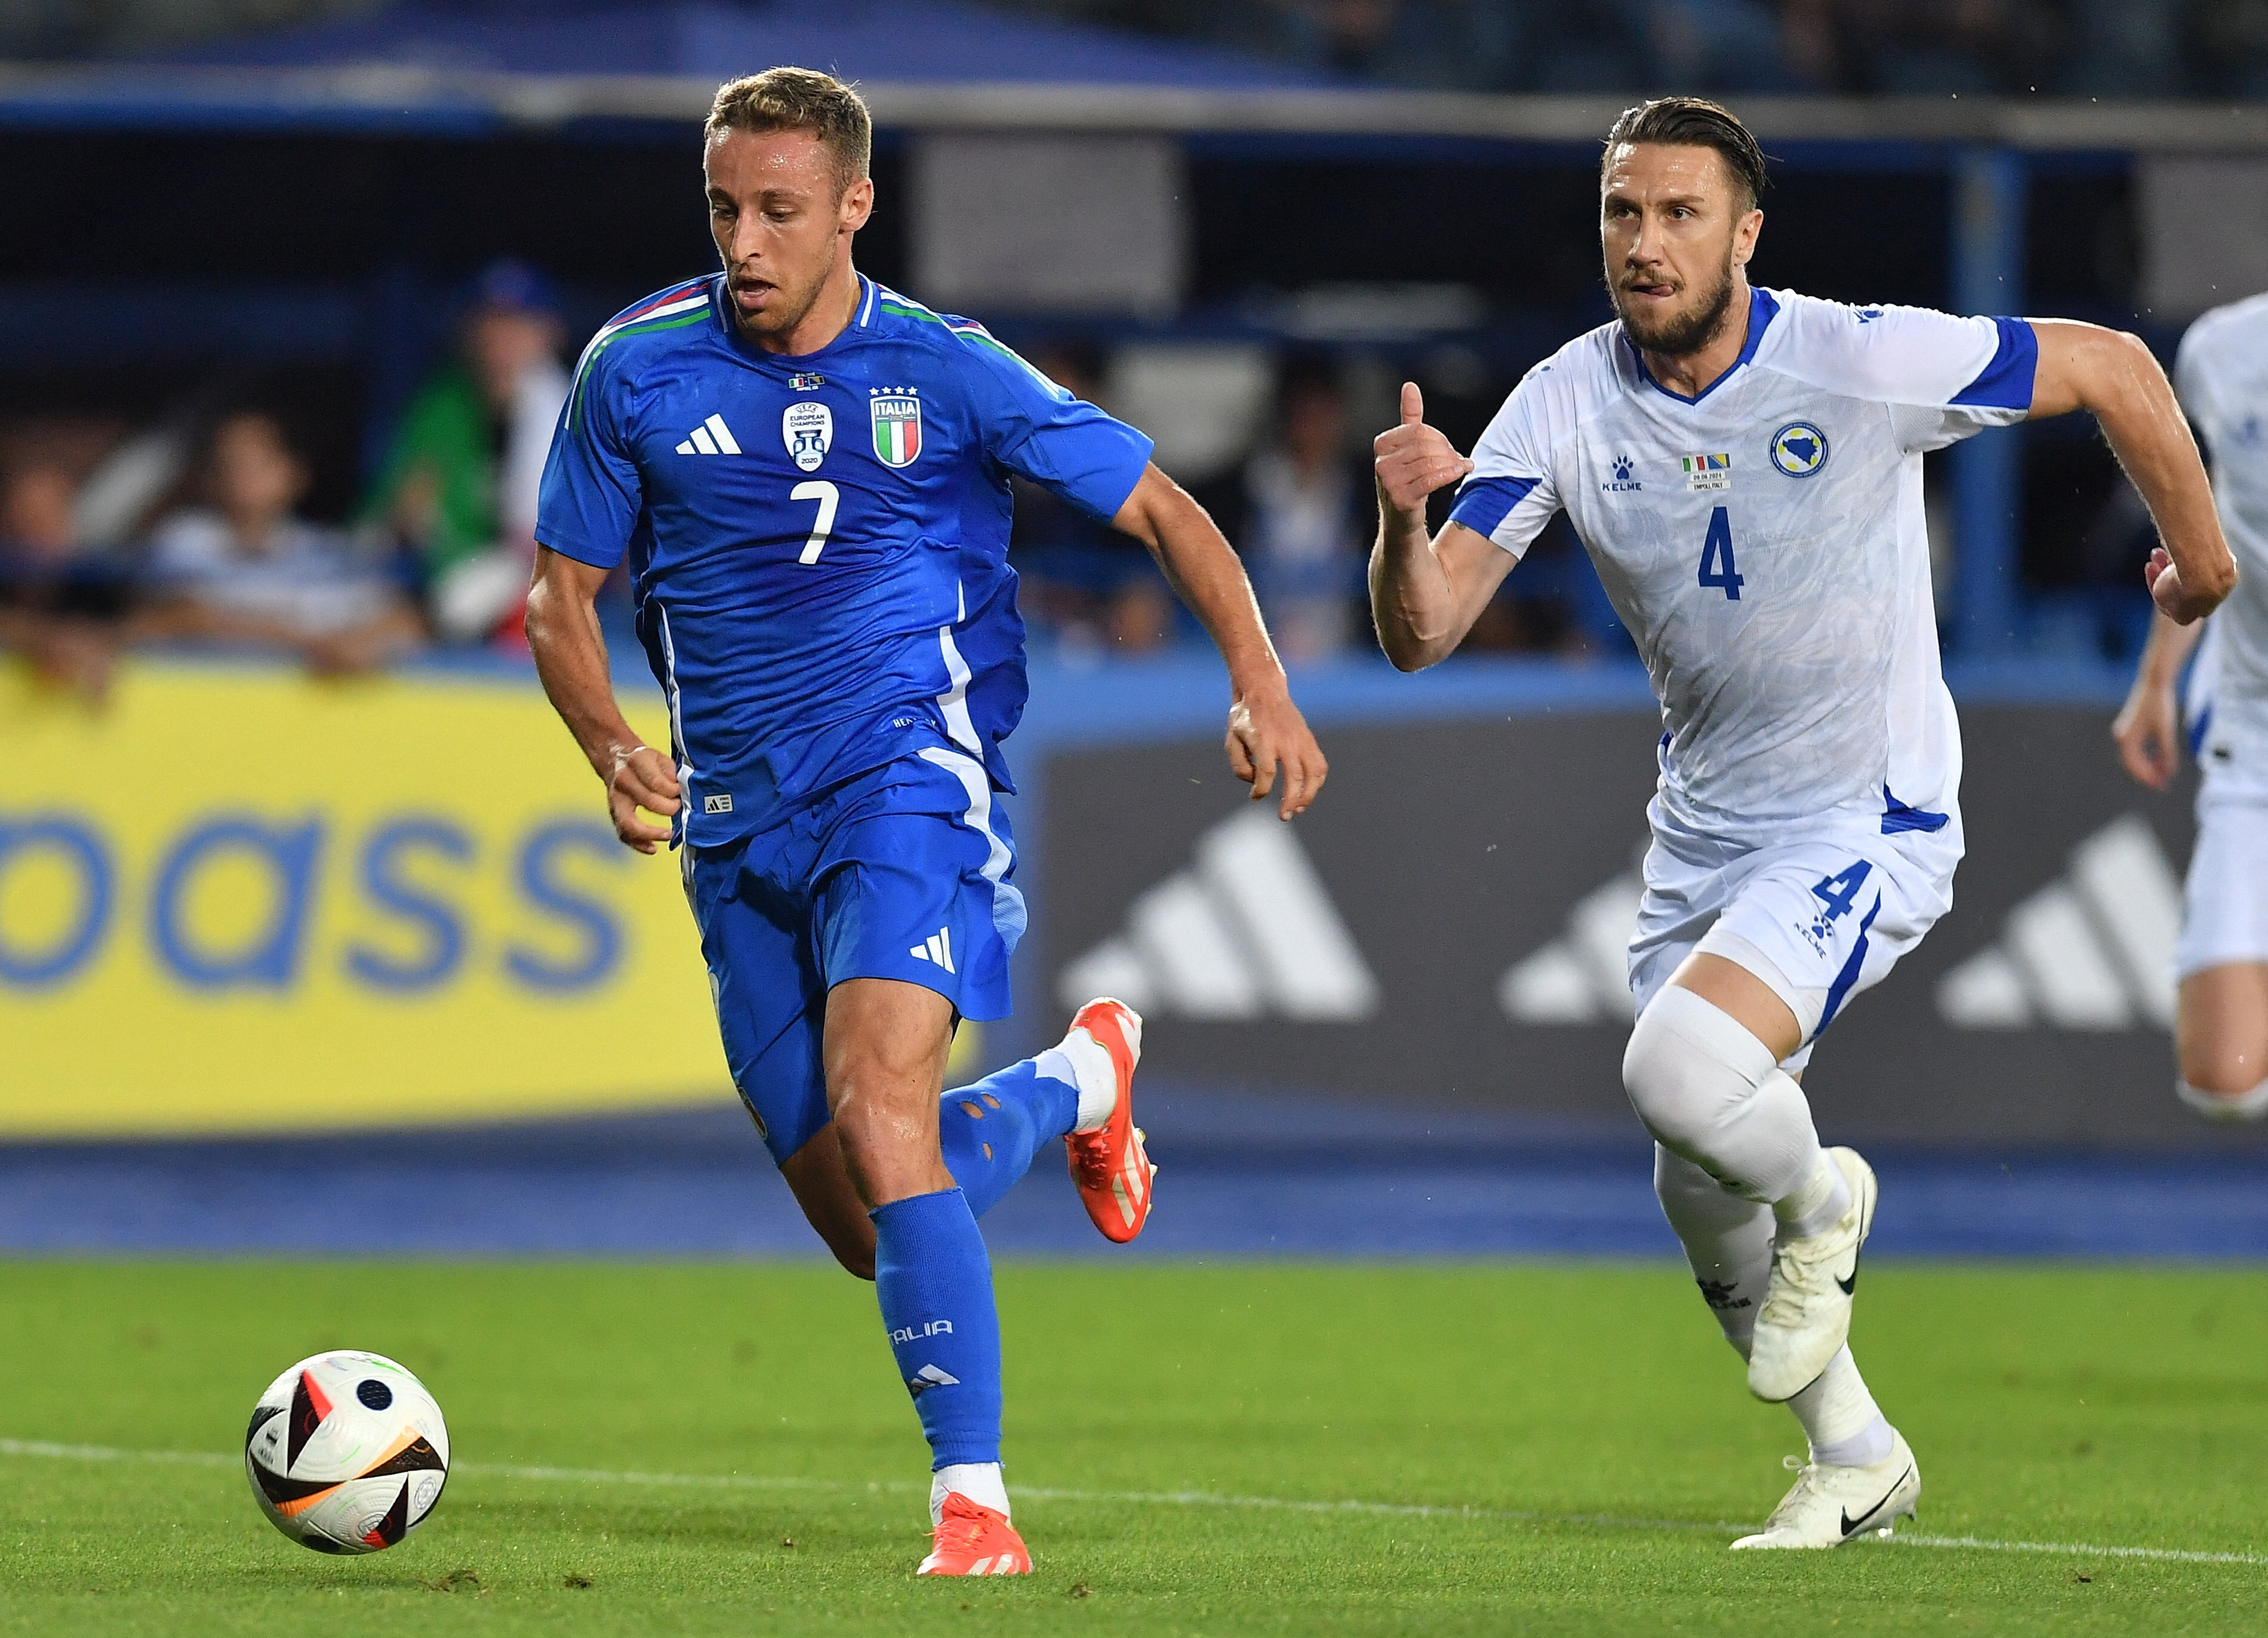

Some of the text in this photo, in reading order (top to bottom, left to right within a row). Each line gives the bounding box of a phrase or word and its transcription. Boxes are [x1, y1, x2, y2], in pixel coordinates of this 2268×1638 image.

[796, 405, 817, 413] UEFA
[875, 402, 916, 415] ITALIA
[1602, 482, 1642, 491] KELME
[790, 480, 840, 564] 7
[1698, 506, 1745, 600] 4
[1811, 858, 1873, 922] 4
